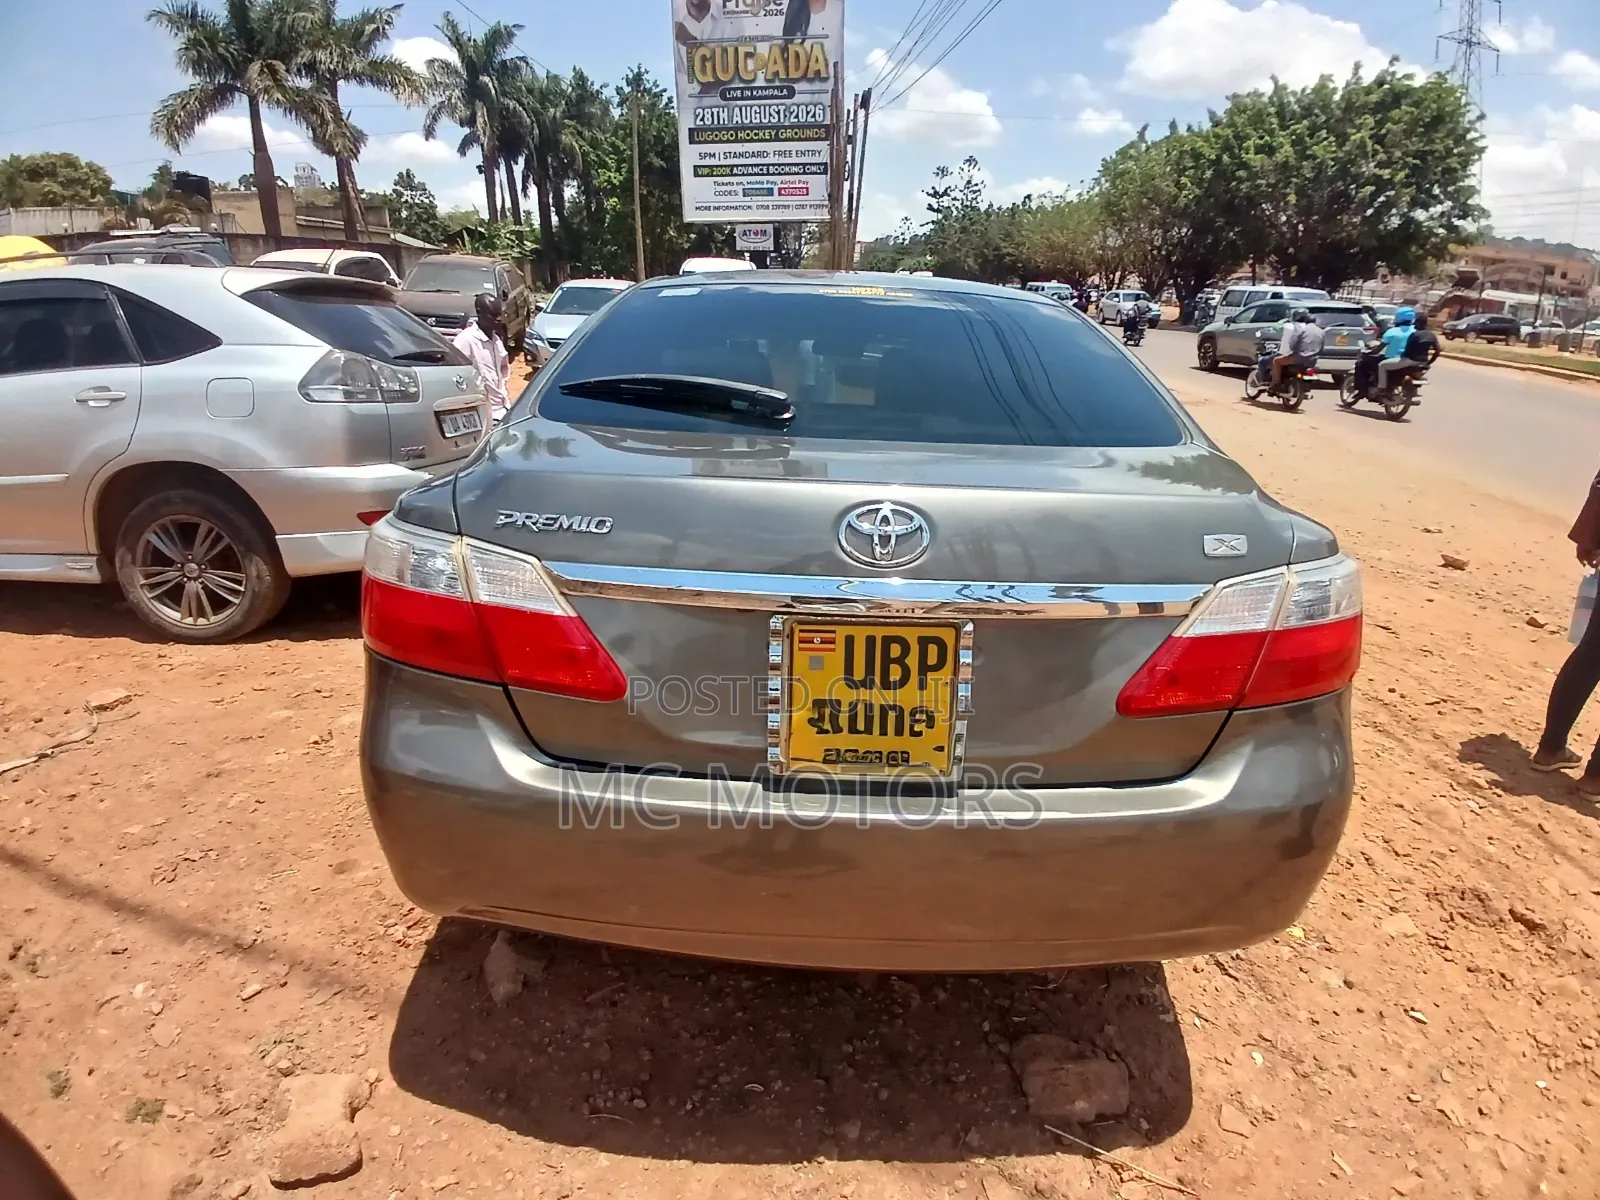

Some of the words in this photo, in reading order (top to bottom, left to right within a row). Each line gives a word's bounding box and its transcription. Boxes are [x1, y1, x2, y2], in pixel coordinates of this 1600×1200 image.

[763, 8, 785, 17] 2026
[766, 43, 829, 80] ADA
[753, 89, 788, 97] KAMPALA
[695, 107, 728, 125] 28TH
[732, 105, 786, 124] AUGUST
[789, 104, 824, 122] 2026
[694, 131, 736, 141] LUGOGO
[738, 130, 776, 140] HOCKEY
[778, 128, 826, 138] GROUNDS
[698, 152, 716, 160] 5PM
[723, 150, 771, 160] STANDARD:
[773, 150, 794, 159] FREE
[795, 149, 822, 157] ENTRY
[713, 167, 731, 175] 200K
[732, 166, 768, 174] ADVANCE
[769, 165, 804, 173] BOOKING
[495, 509, 614, 535] PREMIO
[844, 634, 948, 691] UBP
